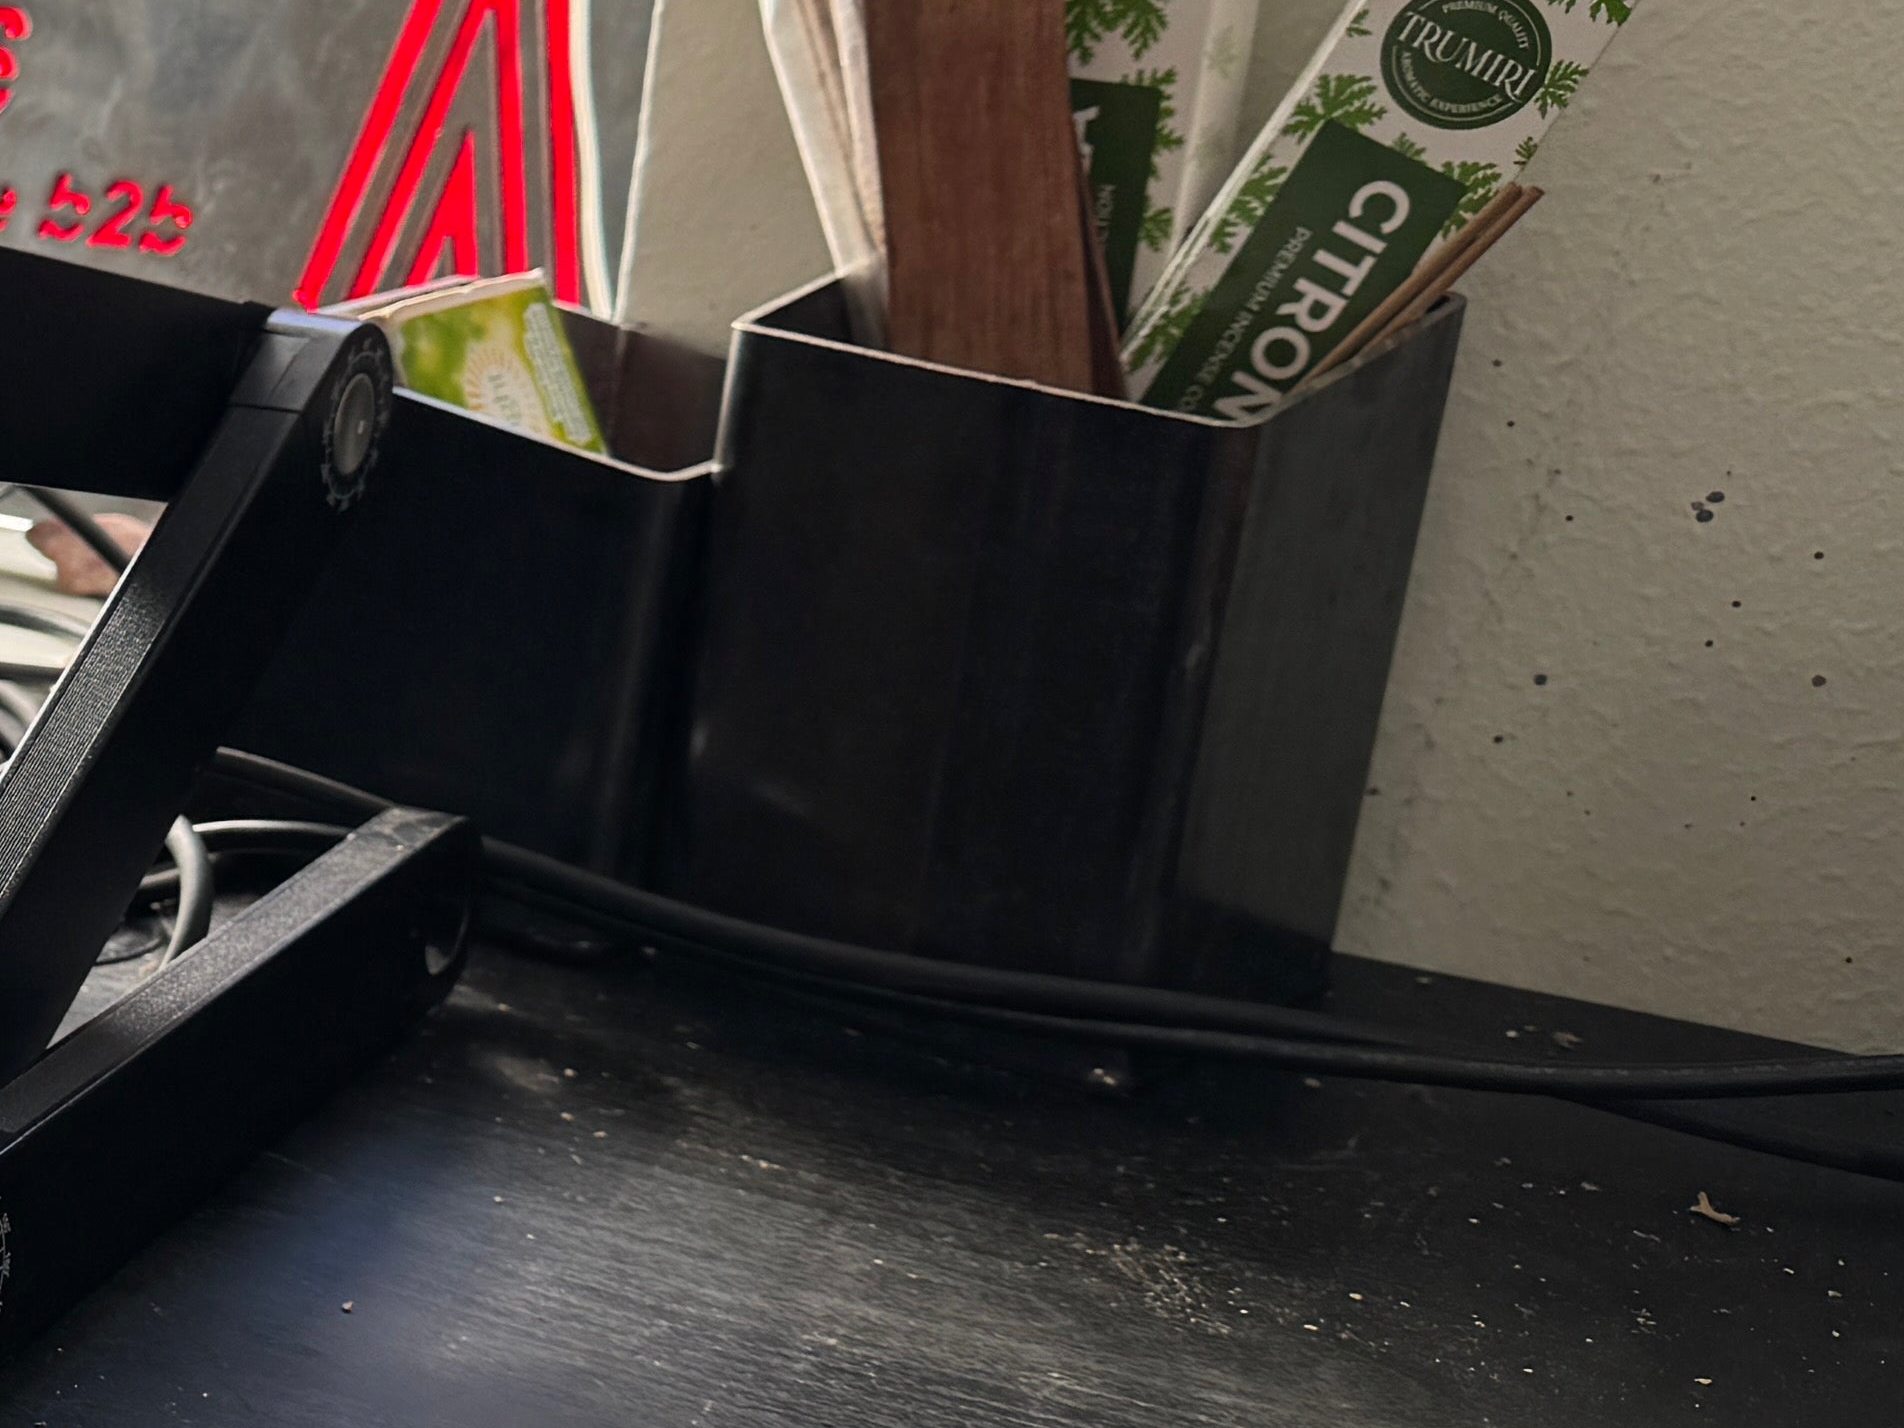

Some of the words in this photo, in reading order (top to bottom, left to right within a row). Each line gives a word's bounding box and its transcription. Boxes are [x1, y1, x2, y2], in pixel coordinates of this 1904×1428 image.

[1397, 10, 1537, 104] TRUMIRI
[1442, 0, 1500, 15] PREMIUM
[1498, 9, 1531, 50] QUALITY
[36, 171, 195, 257] b2b
[1243, 226, 1314, 314] PREMIUM
